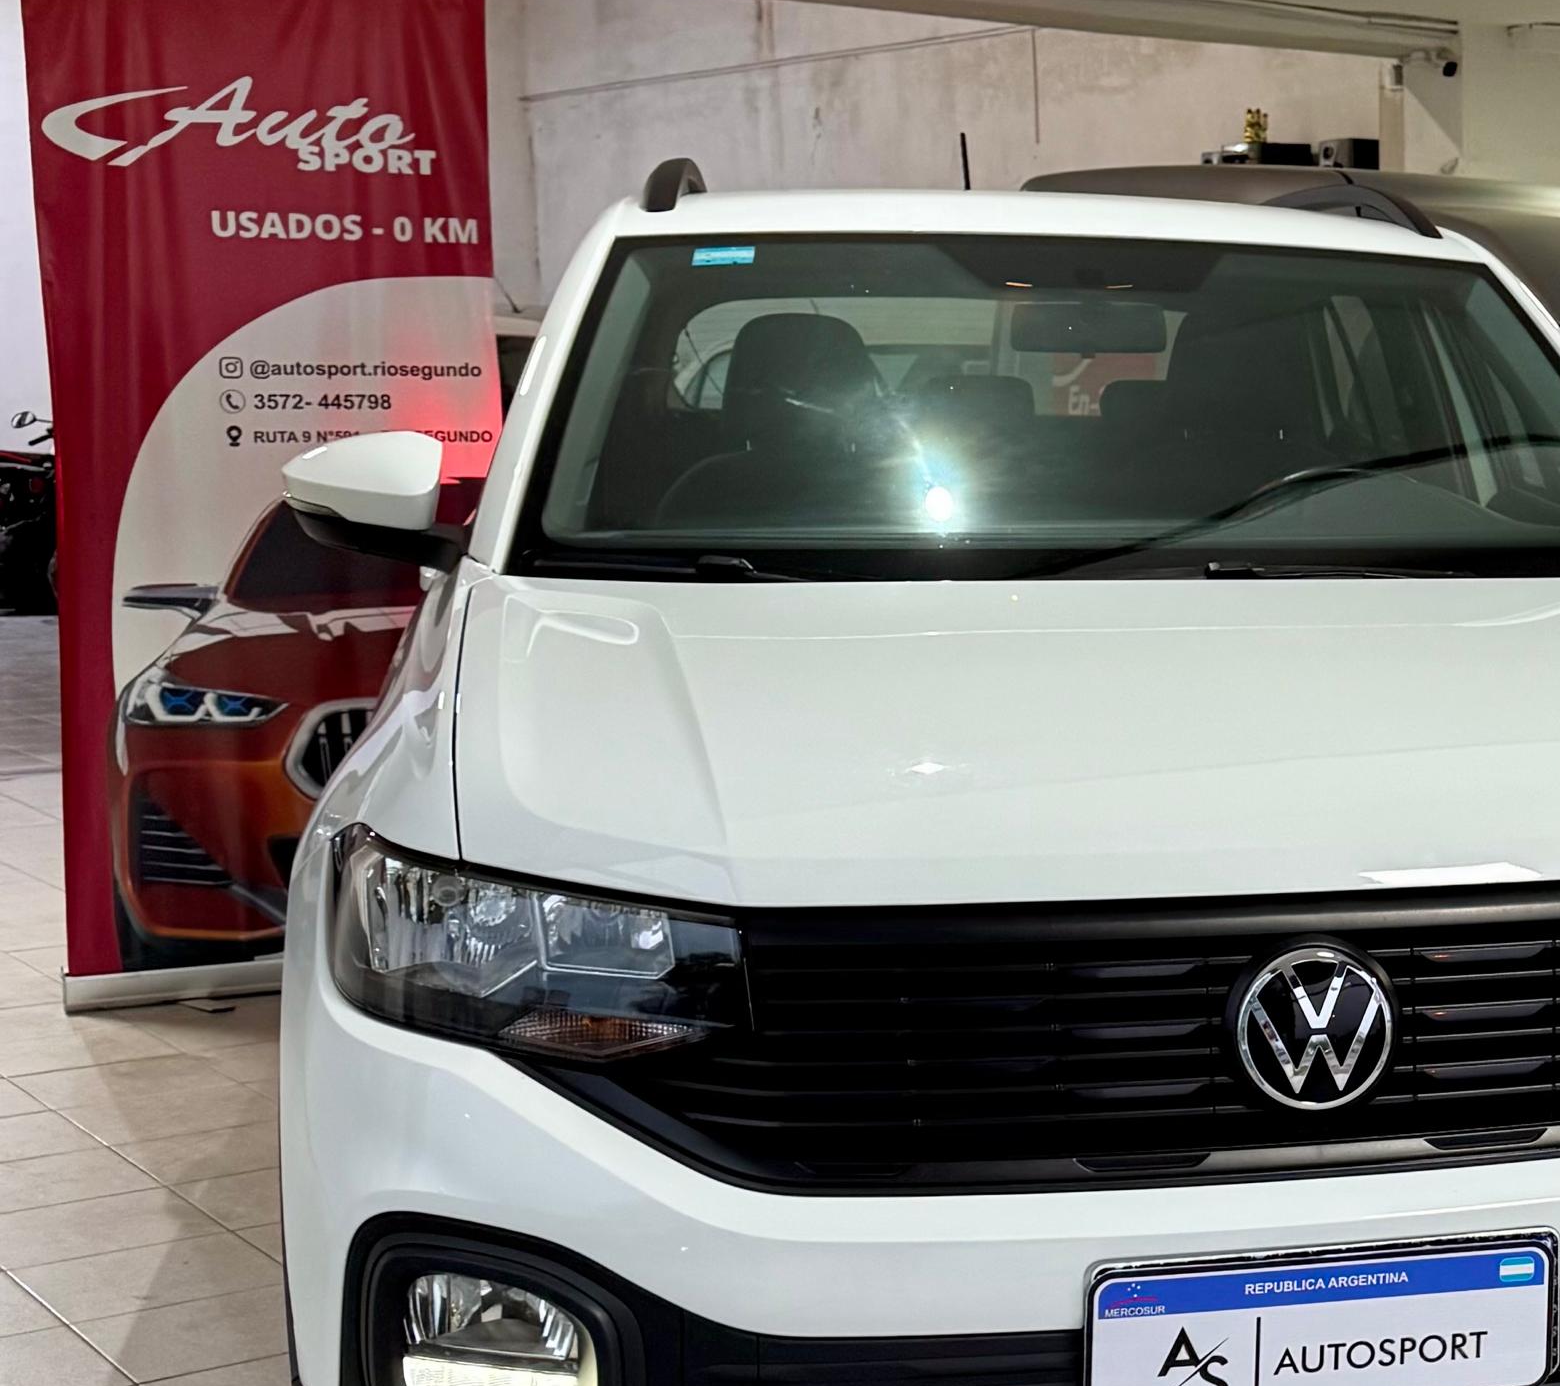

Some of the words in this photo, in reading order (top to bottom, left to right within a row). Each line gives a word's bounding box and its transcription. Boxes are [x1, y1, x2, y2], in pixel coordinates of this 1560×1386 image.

[107, 76, 415, 166] Auto
[297, 146, 437, 176] SPORT
[211, 210, 363, 241] USADOS
[393, 216, 413, 242] 0
[424, 217, 479, 244] KM
[250, 360, 483, 381] @autosport.riosegundo
[253, 393, 312, 410] 3572-
[317, 393, 392, 410] 445798
[253, 430, 298, 443] RUTA
[303, 430, 311, 443] 9
[1244, 1278, 1326, 1296] REPUBLICA
[1327, 1271, 1409, 1289] ARGENTINA
[1104, 1305, 1166, 1318] MERCOSUR
[1273, 1330, 1489, 1376] AUTOSPORT
